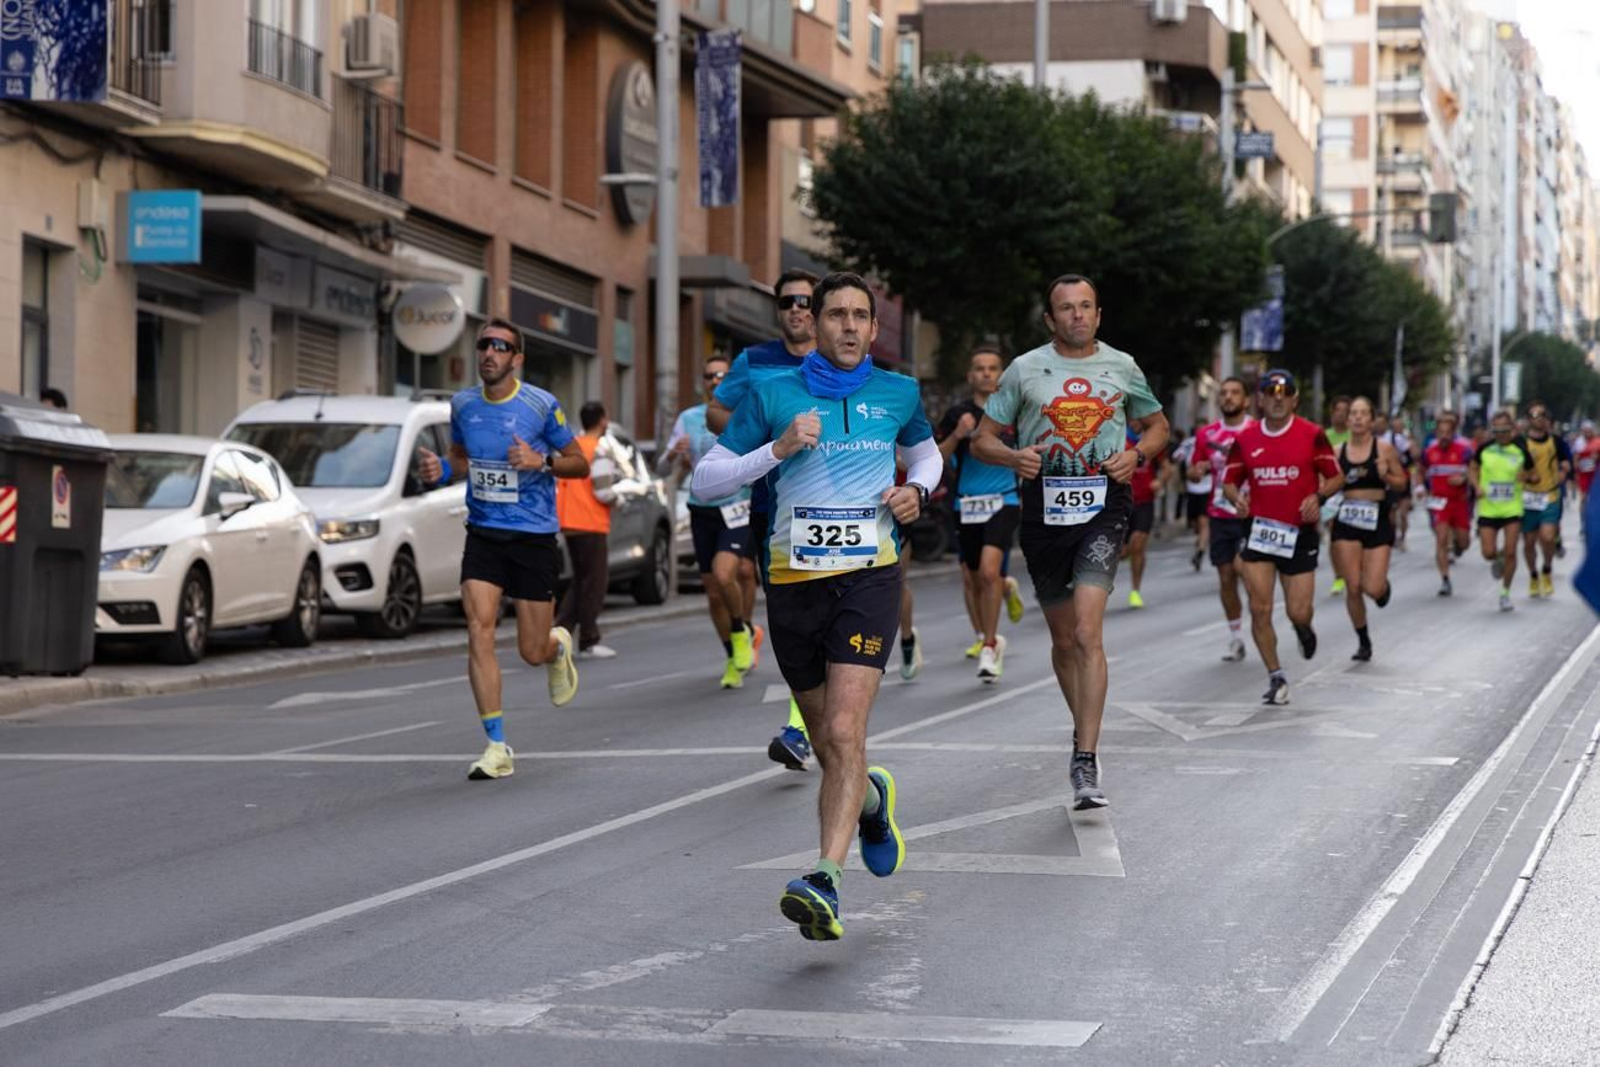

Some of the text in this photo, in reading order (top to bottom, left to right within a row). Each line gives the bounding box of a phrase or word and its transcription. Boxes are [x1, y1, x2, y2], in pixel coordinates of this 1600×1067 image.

[477, 471, 508, 486] 354
[1055, 490, 1095, 507] 459
[807, 524, 862, 546] 325
[1260, 529, 1286, 543] 801
